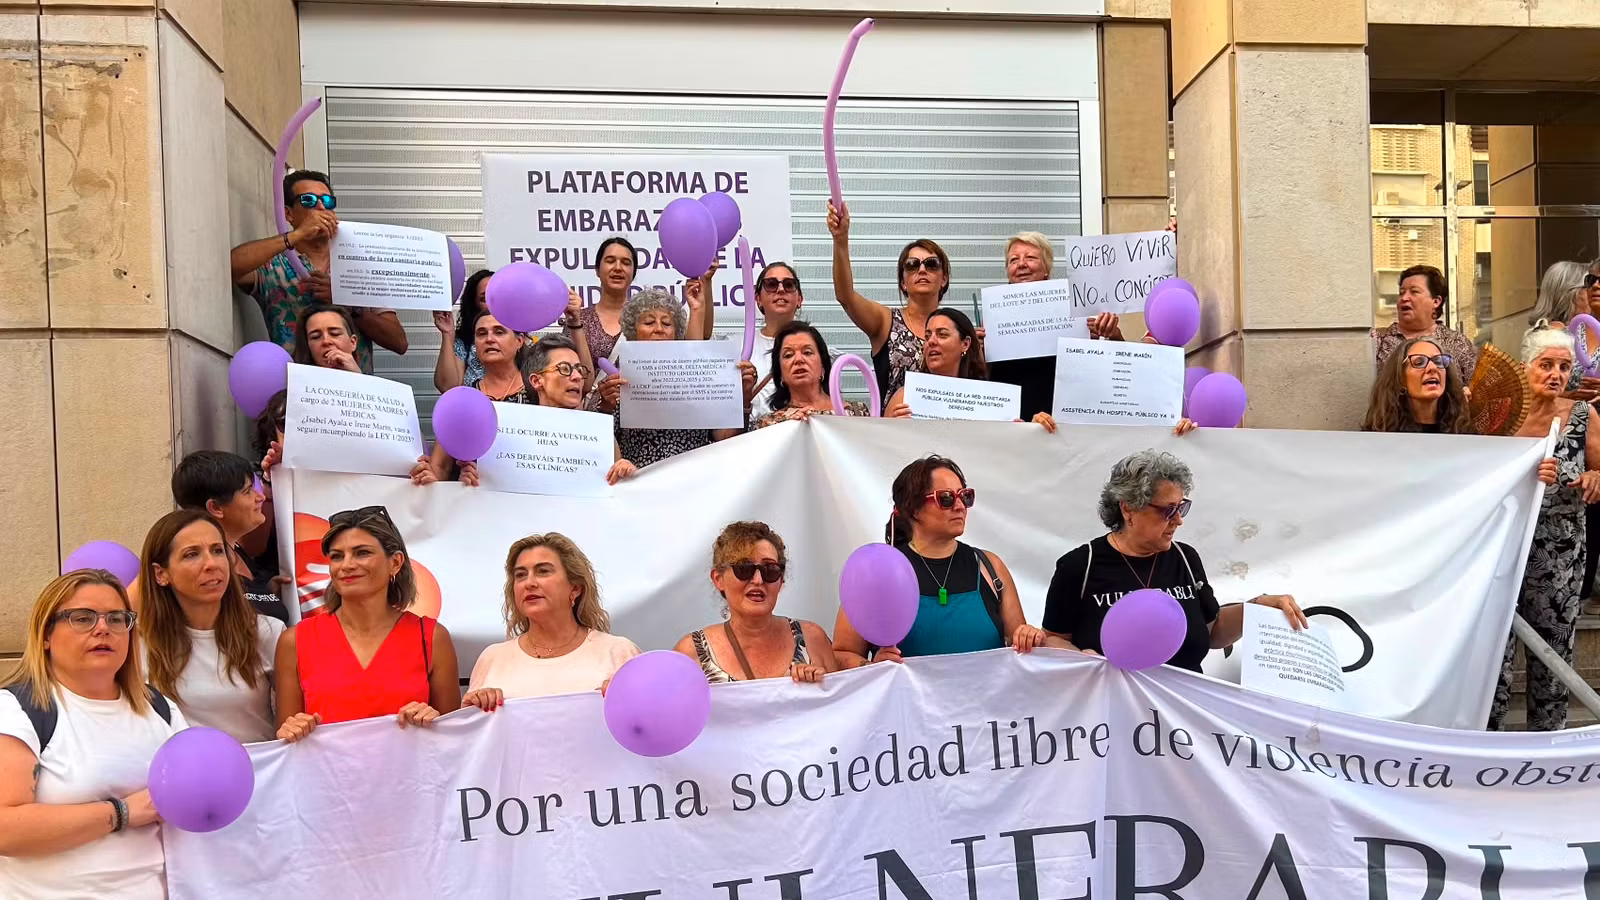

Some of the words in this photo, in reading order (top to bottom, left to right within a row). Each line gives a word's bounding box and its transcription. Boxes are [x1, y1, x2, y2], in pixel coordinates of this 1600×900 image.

[528, 170, 707, 194] PLATAFORMA
[715, 171, 749, 194] DE
[1002, 292, 1024, 300] SOMOS
[1039, 288, 1066, 296] MUJERES
[1072, 283, 1099, 307] NO
[1100, 292, 1109, 303] al
[998, 319, 1045, 329] EMBARAZADAS
[998, 328, 1028, 336] SEMANAS
[1038, 323, 1073, 331] GESTACIÓN
[305, 386, 316, 394] LA
[318, 387, 365, 401] CONSEJERÍA
[366, 394, 376, 402] DE
[377, 395, 401, 406] SALUD
[943, 397, 976, 405] VULNERANDO
[300, 397, 319, 405] cargo
[321, 398, 328, 406] de
[337, 400, 373, 411] MUJERES,
[374, 405, 404, 415] MADRES
[340, 409, 376, 420] MÉDICAS
[1135, 410, 1158, 418] PÚBLICO
[301, 415, 327, 424] ¿Isabel
[328, 418, 347, 428] Ayala
[296, 426, 319, 435] seguir
[320, 427, 366, 438] incumpliendo
[375, 432, 390, 440] LEY
[517, 429, 550, 438] OCURRE
[558, 432, 598, 442] VUESTRAS
[496, 451, 515, 460] ¿LAS
[517, 452, 554, 462] DERIVÁIS
[555, 456, 593, 466] TAMBIÉN
[516, 461, 536, 469] ESAS
[537, 463, 578, 473] CLÍNICAS?
[455, 783, 564, 843] Por
[586, 773, 709, 829] una
[729, 724, 974, 813] sociedad
[986, 715, 1111, 773] libre
[1130, 707, 1197, 762] de
[1209, 728, 1455, 790] violencia
[1474, 759, 1600, 788] obst
